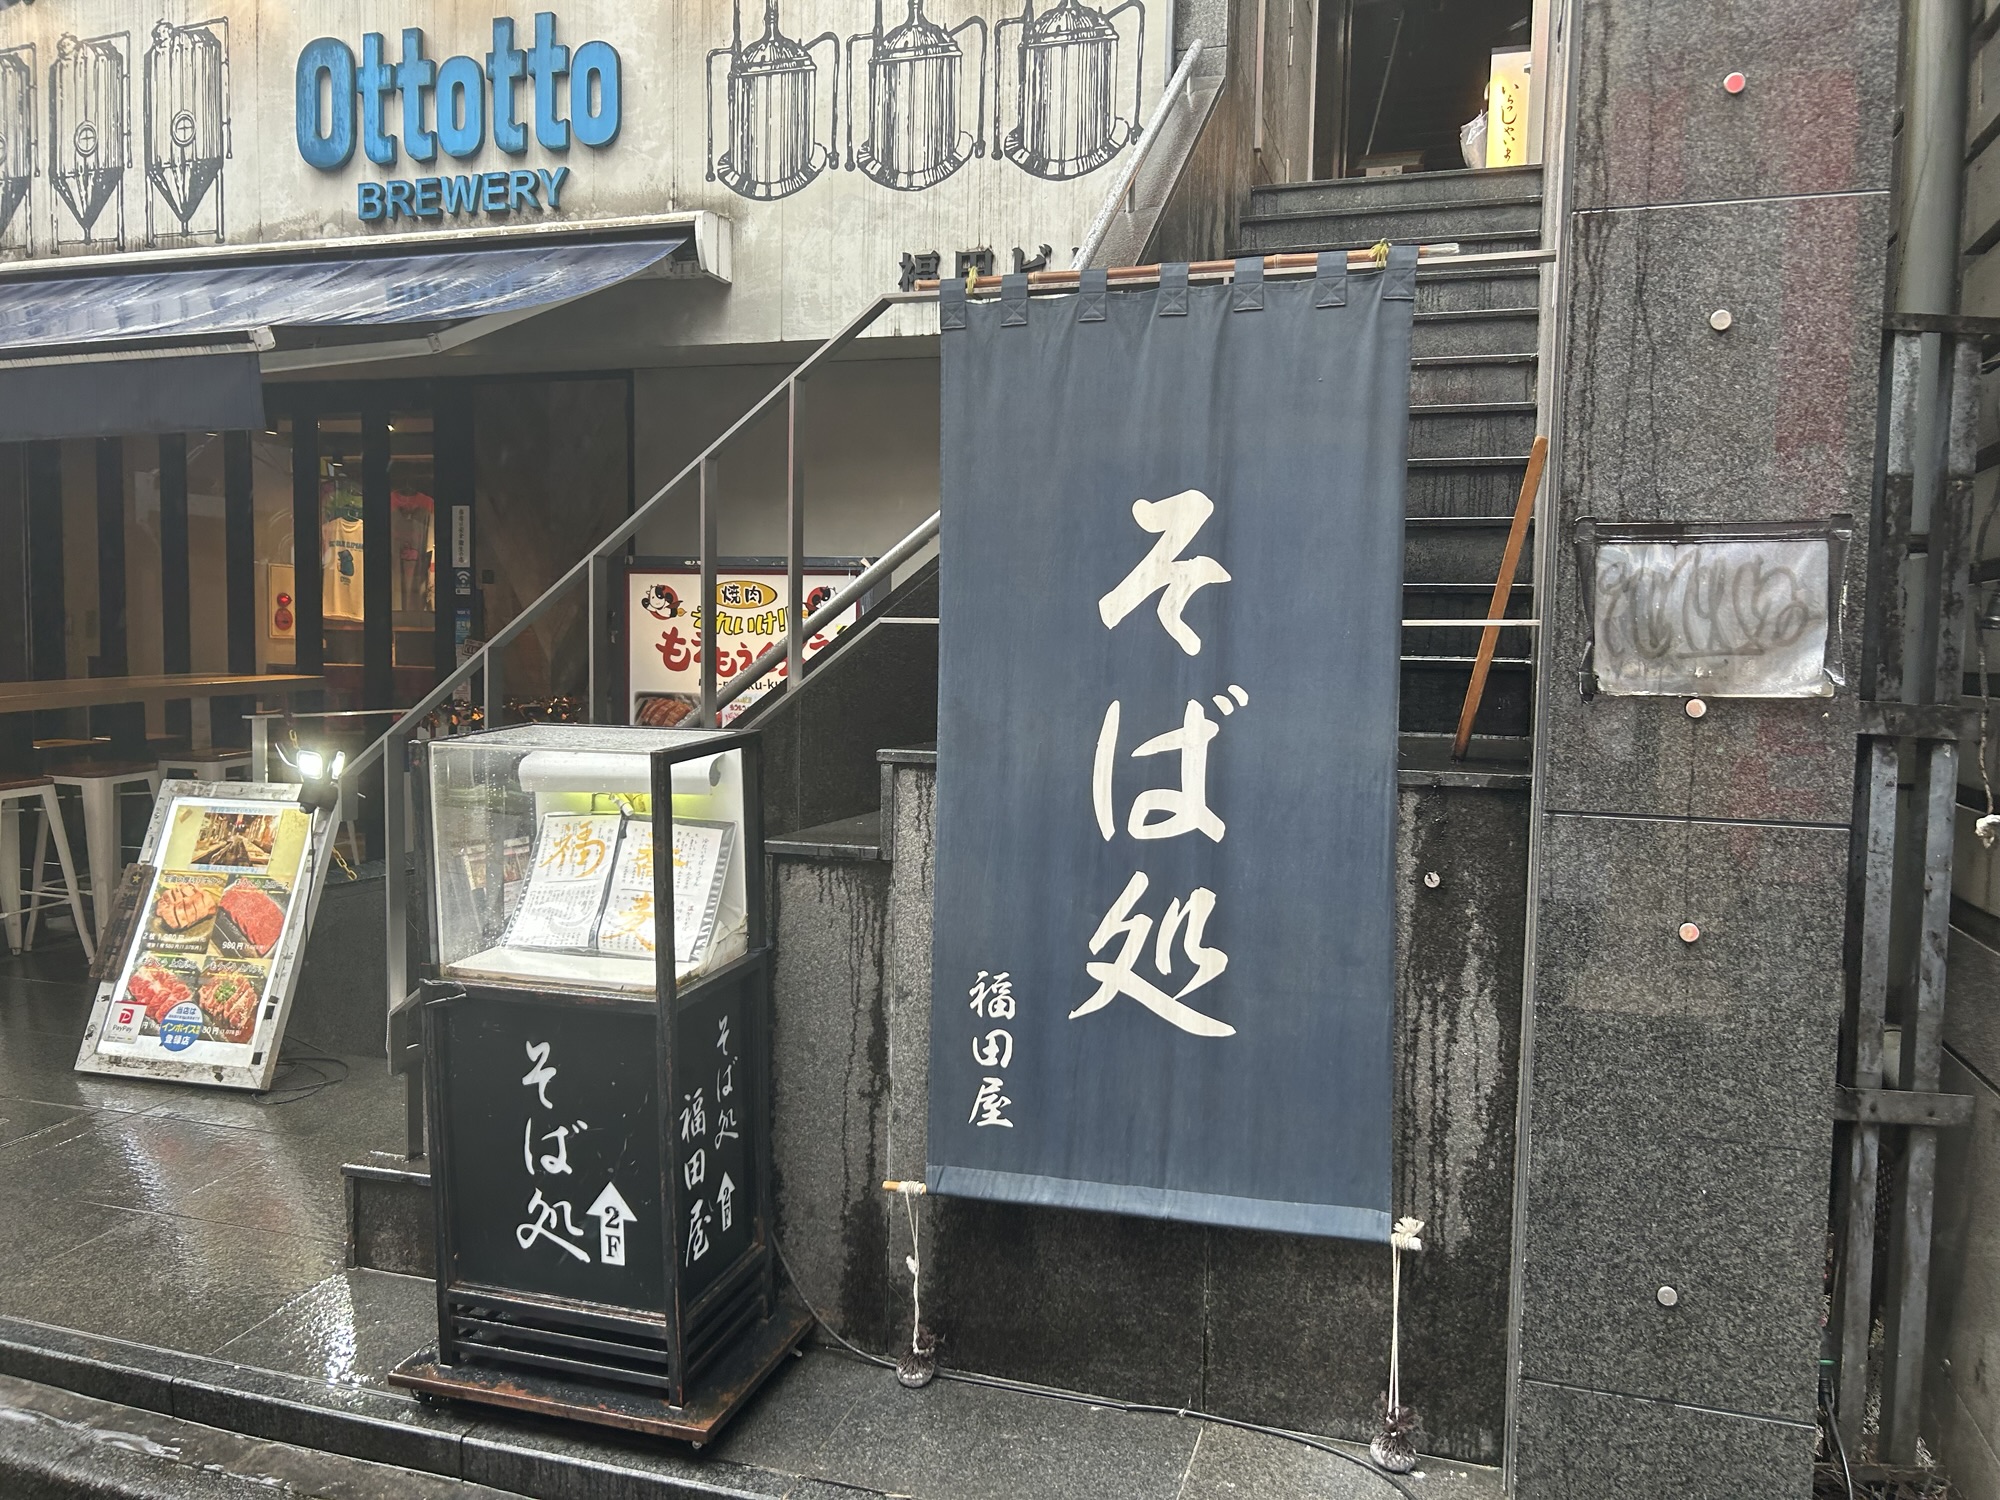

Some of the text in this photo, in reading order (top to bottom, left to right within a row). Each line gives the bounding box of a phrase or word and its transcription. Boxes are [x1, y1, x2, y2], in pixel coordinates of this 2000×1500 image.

[296, 12, 622, 171] Ottotto
[357, 167, 570, 222] BREWERY
[898, 244, 1079, 292] 福田ビ
[721, 583, 763, 606] 焼肉
[1069, 489, 1250, 1037] そば処
[538, 821, 606, 878] 福
[112, 1024, 134, 1033] PayPay
[176, 1005, 197, 1015] 当店は
[163, 1034, 191, 1046] 登録店
[968, 970, 1016, 1130] 福田屋
[715, 1015, 739, 1150] そば処
[516, 1040, 591, 1264] そば処
[680, 1087, 712, 1267] 福田屋
[604, 1206, 622, 1258] 2F
